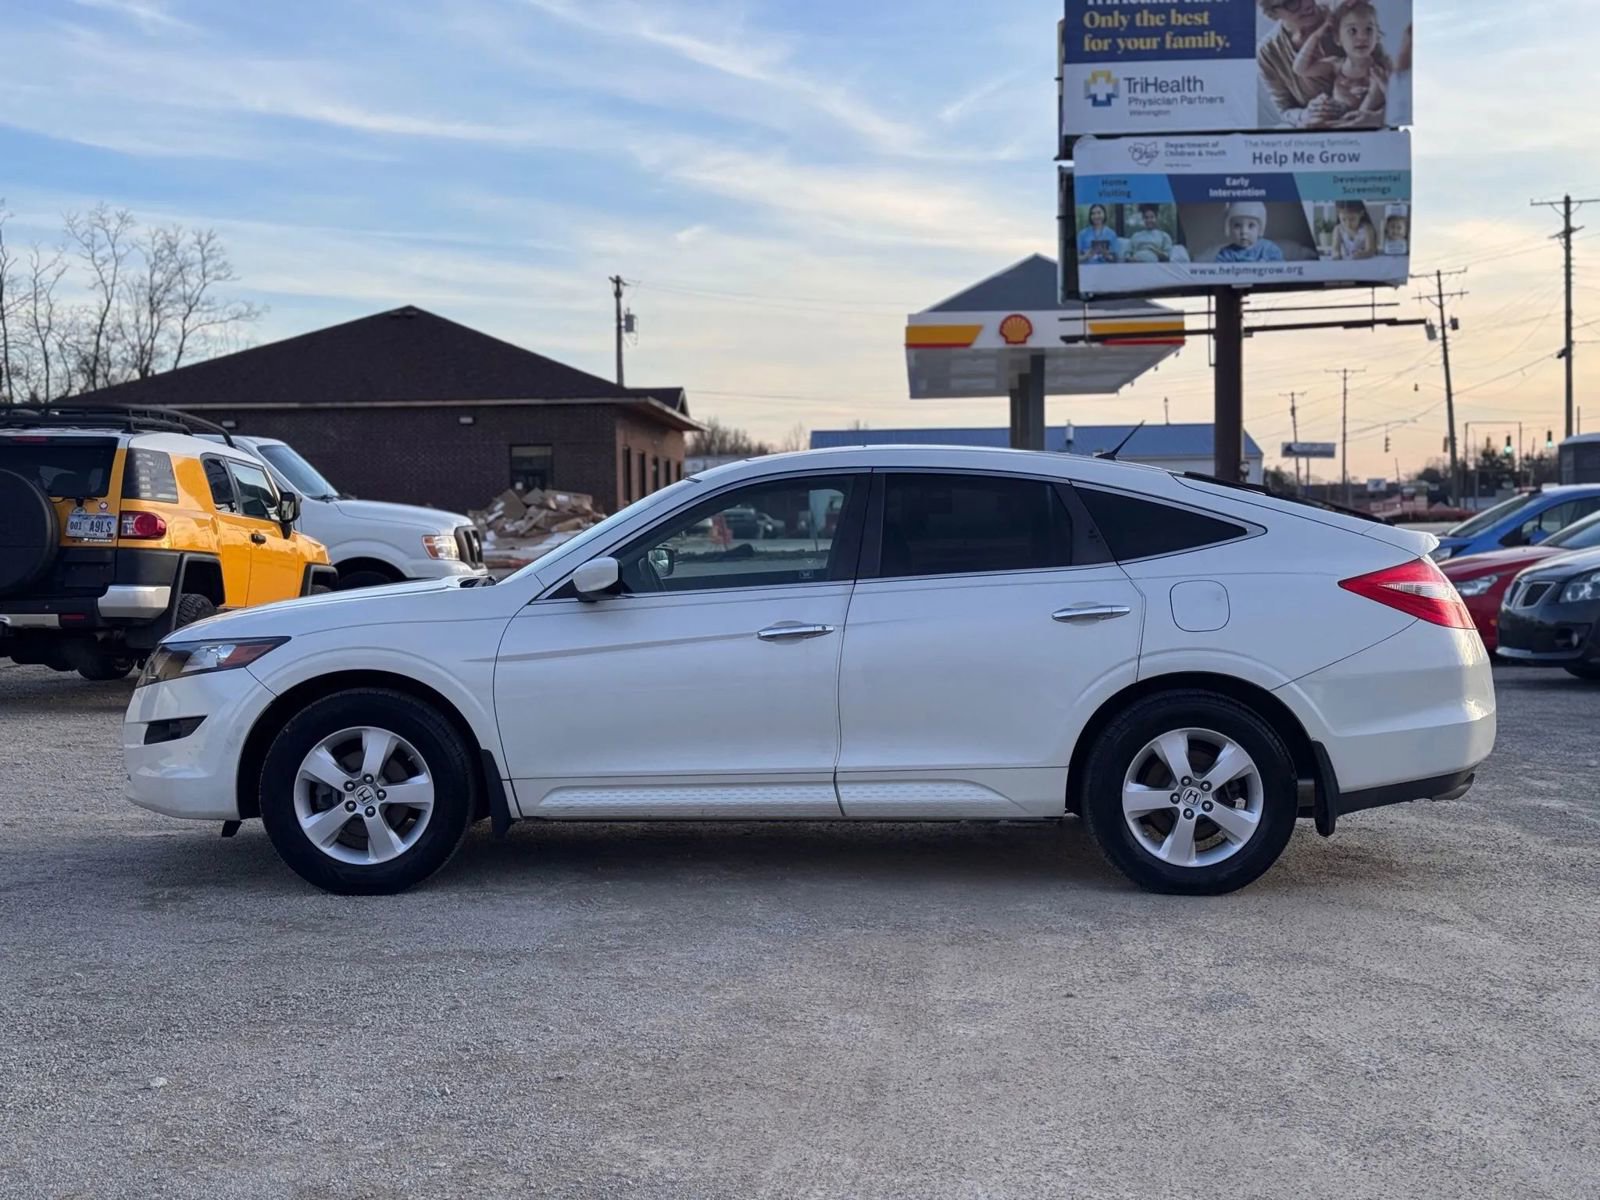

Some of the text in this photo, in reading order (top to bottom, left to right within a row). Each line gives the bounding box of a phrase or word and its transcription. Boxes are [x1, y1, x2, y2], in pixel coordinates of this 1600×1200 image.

[1083, 9, 1210, 31] Only the best
[1084, 31, 1230, 54] for your family.
[1123, 75, 1204, 94] TriHealth
[1128, 95, 1224, 108] Physician Partners
[1244, 139, 1258, 147] The
[1252, 149, 1361, 168] Help Me Grow
[1101, 178, 1129, 187] Home
[1225, 176, 1250, 188] Early
[1332, 173, 1401, 185] Developmental
[1209, 187, 1266, 198] Intervention
[1189, 265, 1304, 277] www.helpmegrow.org
